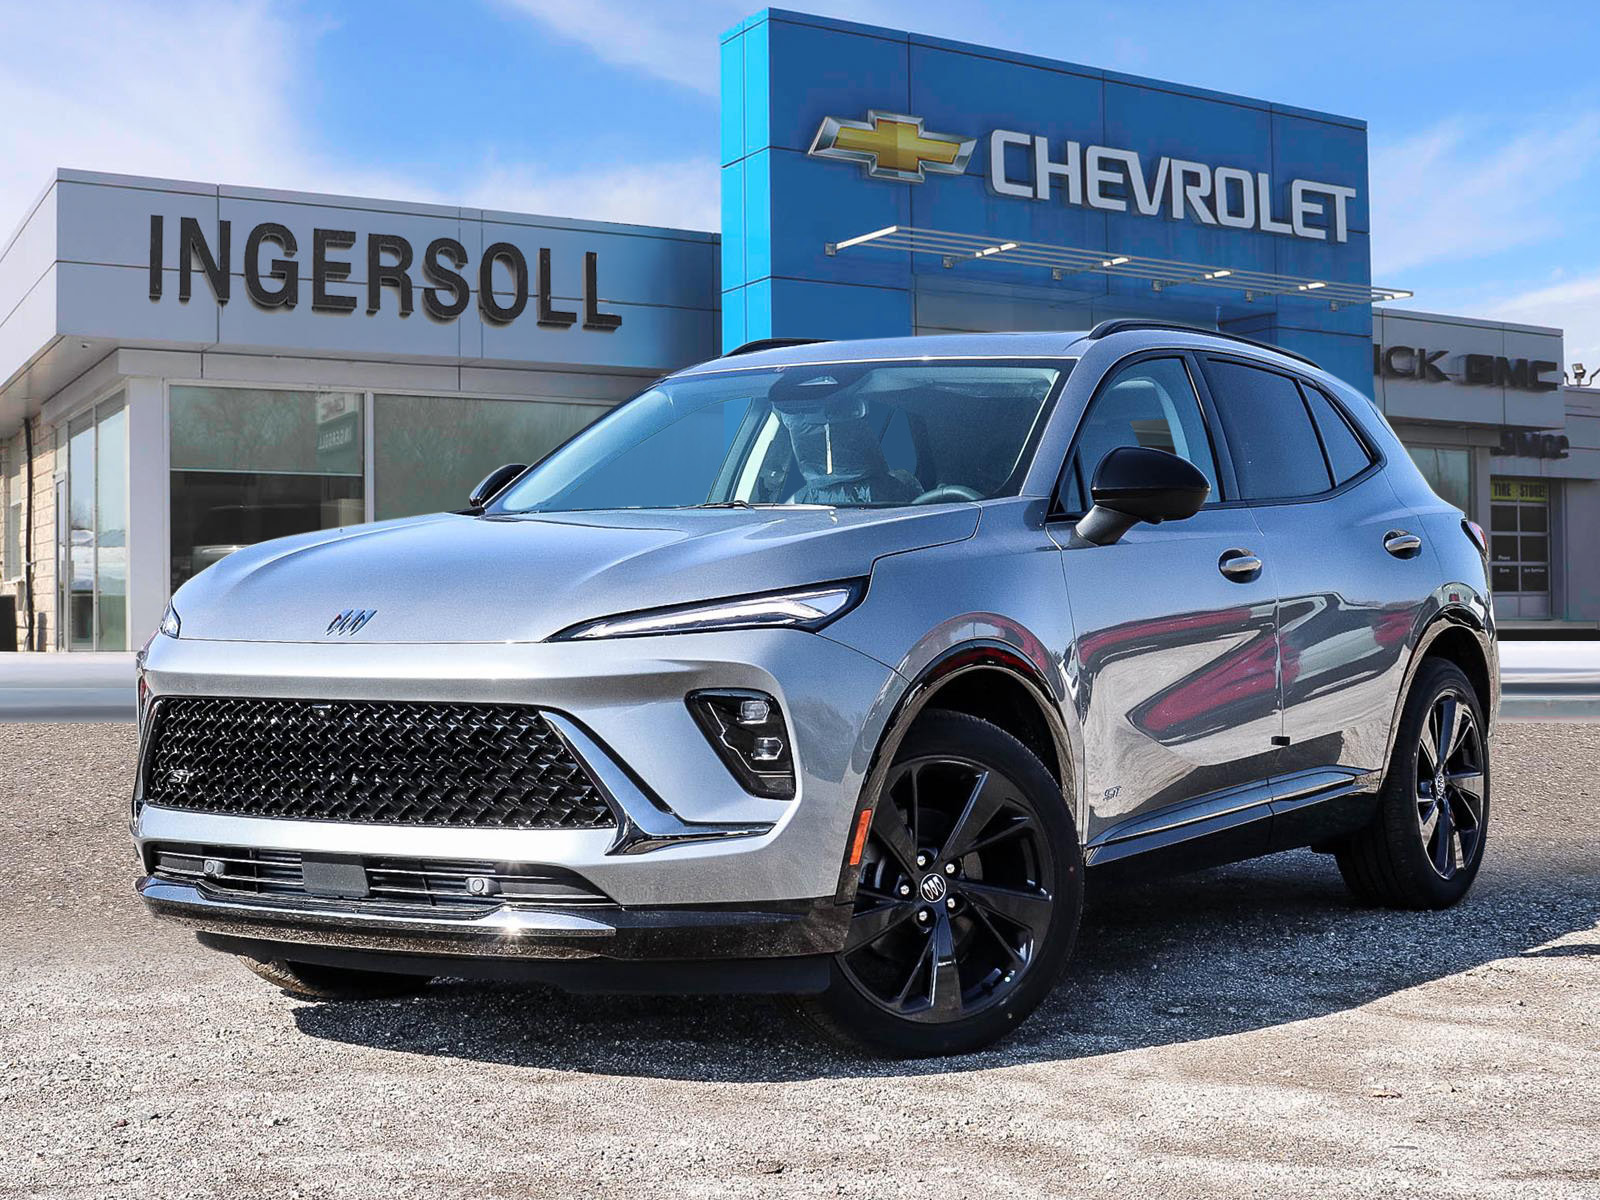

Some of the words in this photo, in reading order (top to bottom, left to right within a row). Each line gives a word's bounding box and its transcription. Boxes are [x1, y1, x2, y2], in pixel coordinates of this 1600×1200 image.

[991, 128, 1357, 243] CHEVROLET
[148, 214, 623, 332] INGERSOLL
[1373, 344, 1450, 381] ICK
[1466, 354, 1557, 390] GMC
[169, 769, 190, 784] ST
